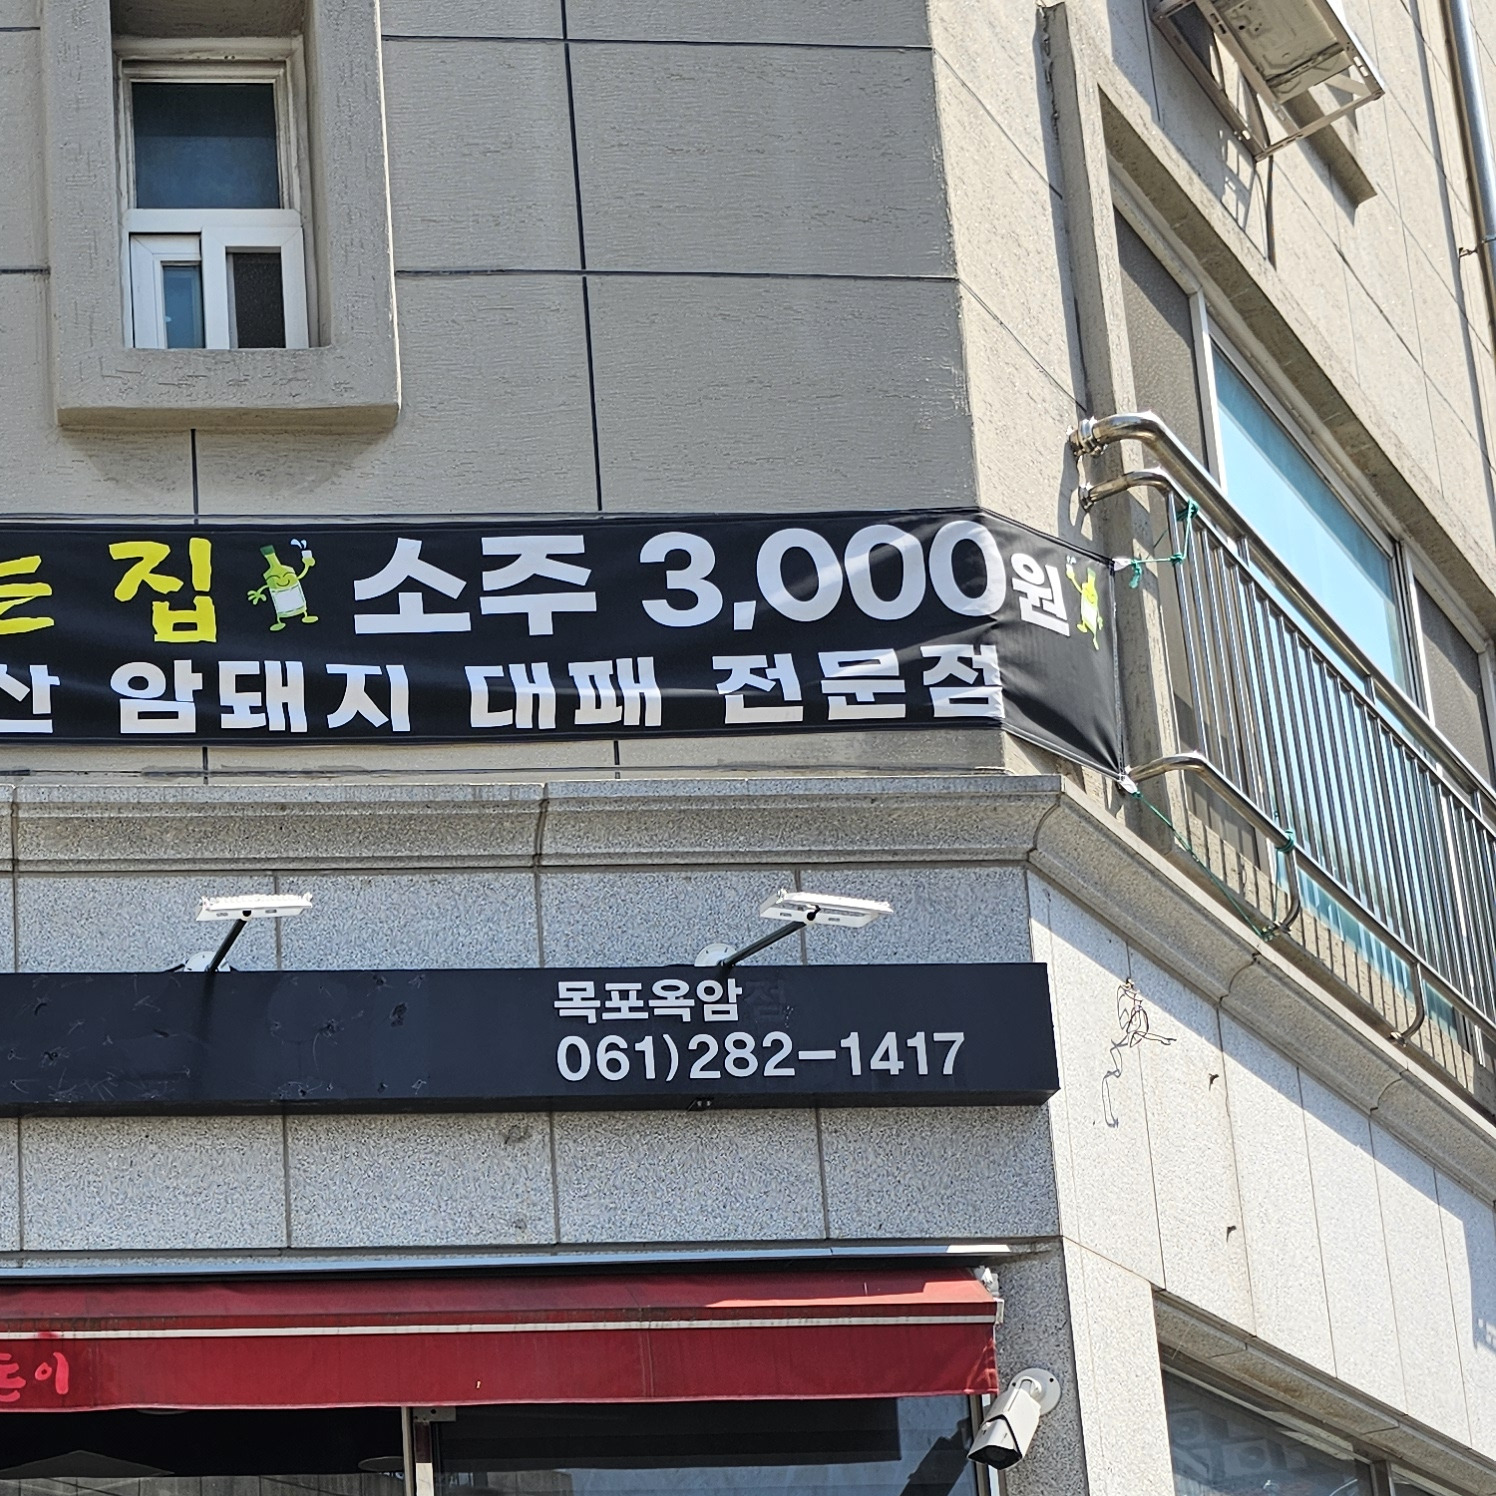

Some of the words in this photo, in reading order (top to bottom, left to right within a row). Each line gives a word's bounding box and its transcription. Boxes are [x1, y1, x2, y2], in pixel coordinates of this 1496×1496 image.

[108, 537, 217, 643] 집
[352, 534, 597, 637] 소주
[640, 519, 1071, 638] 3,000원
[109, 660, 410, 735] 암돼지
[464, 655, 663, 729] 대패
[713, 643, 1004, 725] 전문점
[555, 1030, 966, 1082] 061)282-1417
